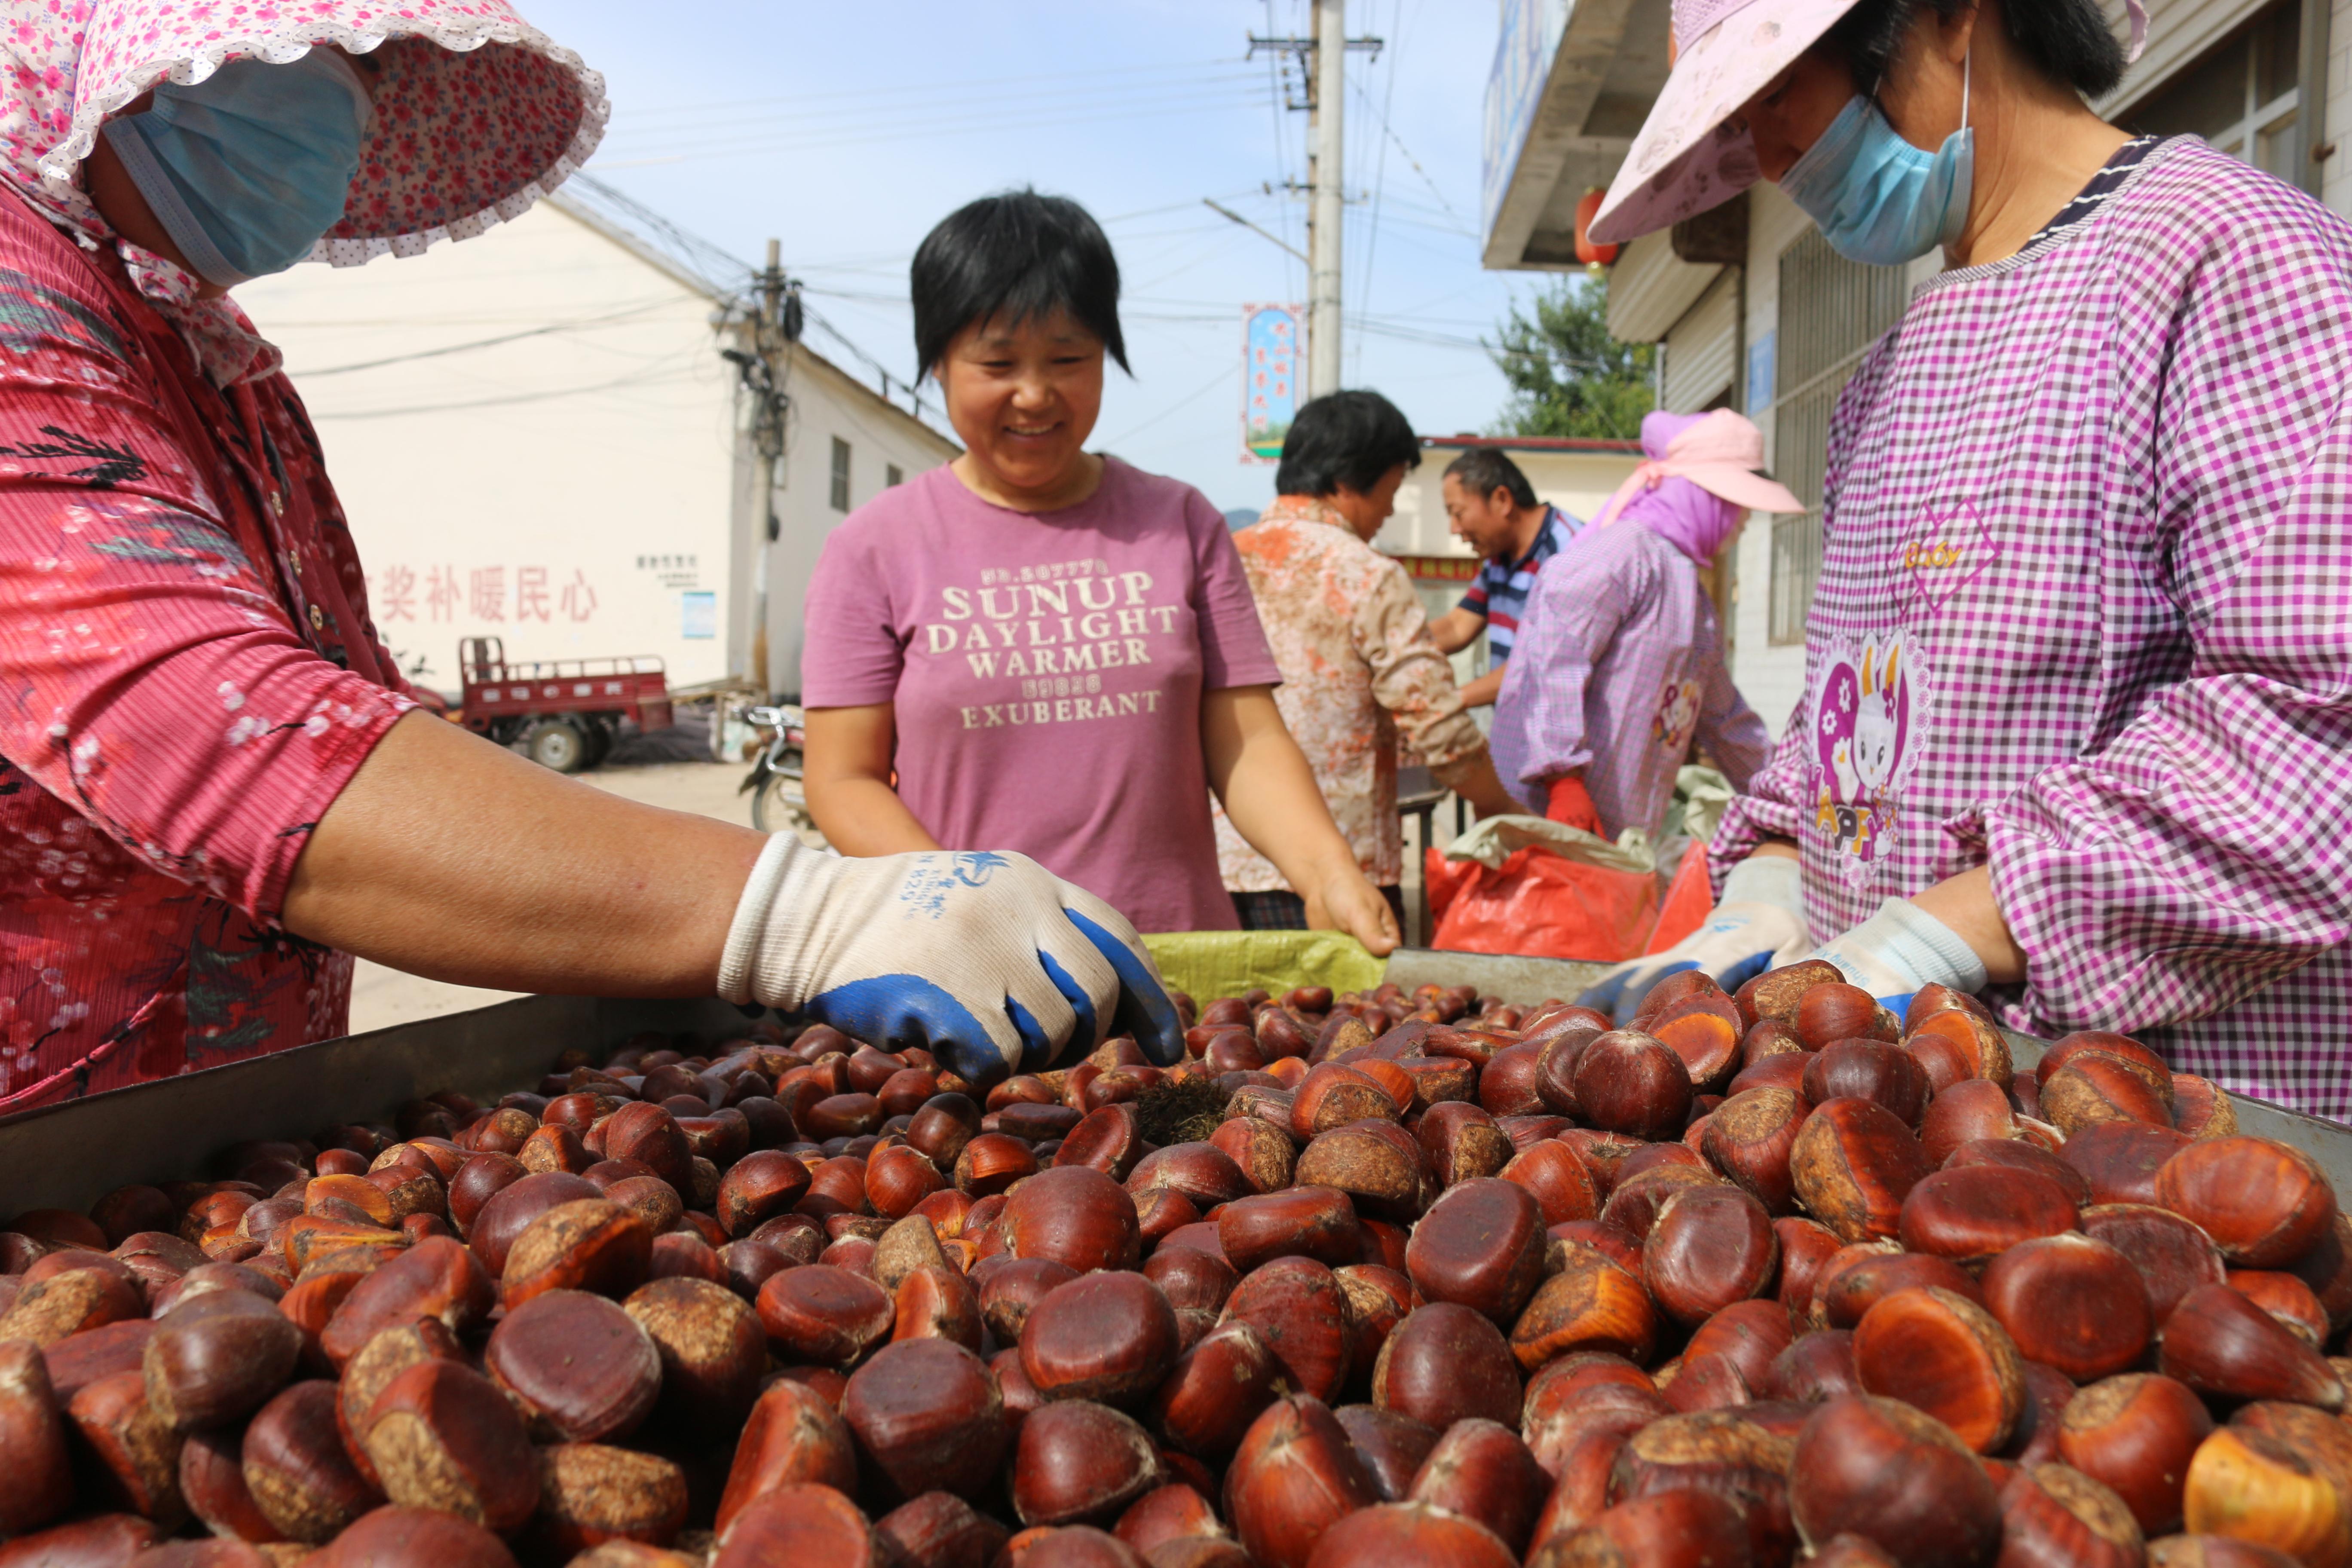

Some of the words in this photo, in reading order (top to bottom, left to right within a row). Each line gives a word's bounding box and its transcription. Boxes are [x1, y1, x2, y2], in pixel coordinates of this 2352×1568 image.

[1905, 540, 1963, 569] Baby
[365, 564, 598, 623] 奖补暖民心
[942, 571, 1153, 620] SUNUP
[926, 606, 1179, 654] DAYLIGHT
[967, 638, 1152, 679] WARMER
[961, 690, 1162, 729] EXUBERANT
[1806, 763, 1885, 862] HAPPY
